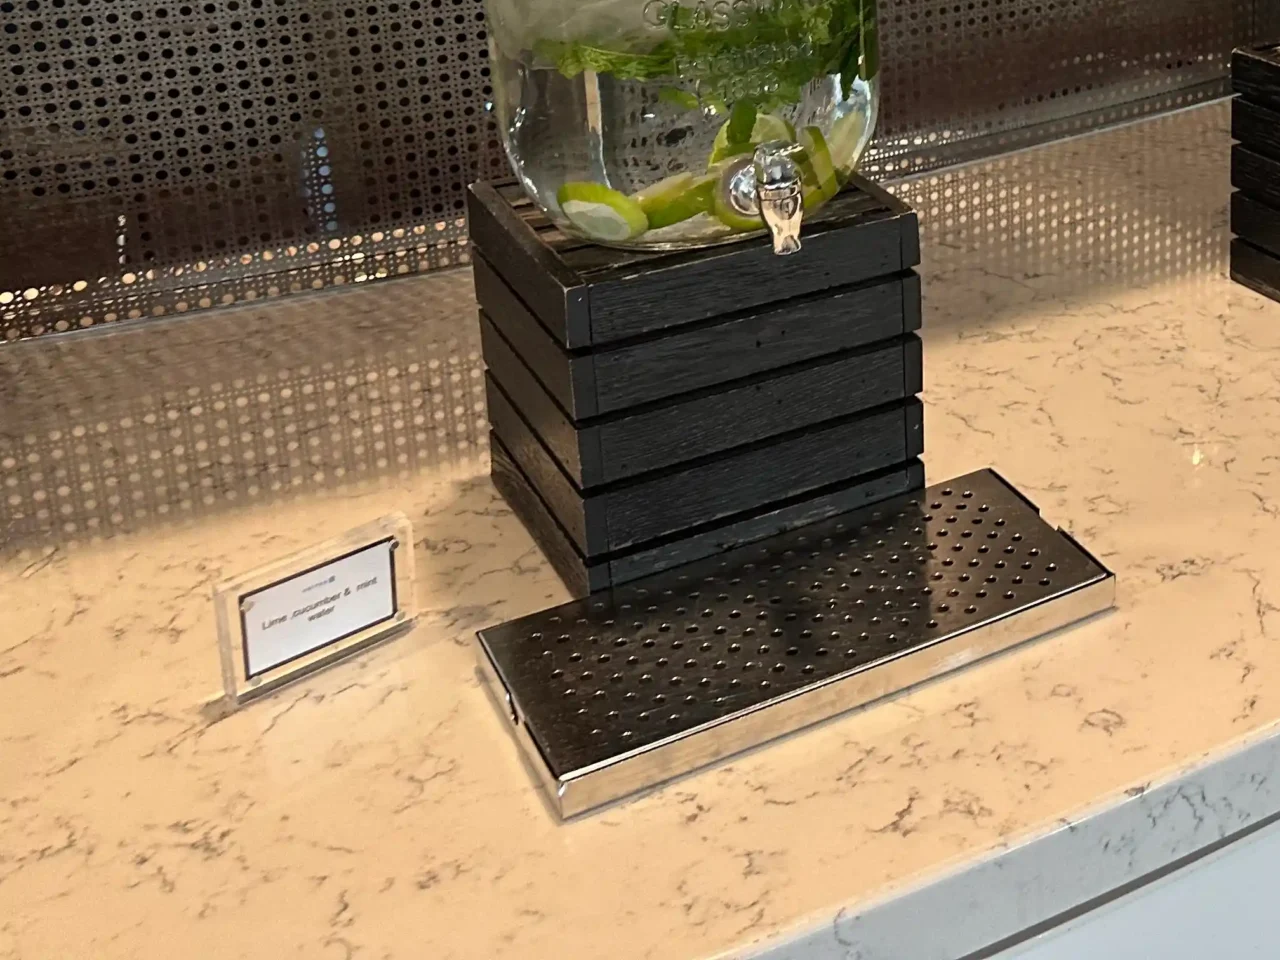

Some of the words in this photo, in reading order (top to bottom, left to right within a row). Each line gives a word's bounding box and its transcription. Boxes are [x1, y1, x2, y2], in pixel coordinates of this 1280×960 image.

[261, 613, 288, 631] Lime
[343, 586, 351, 597] &
[356, 576, 378, 592] mint
[307, 605, 336, 622] water
